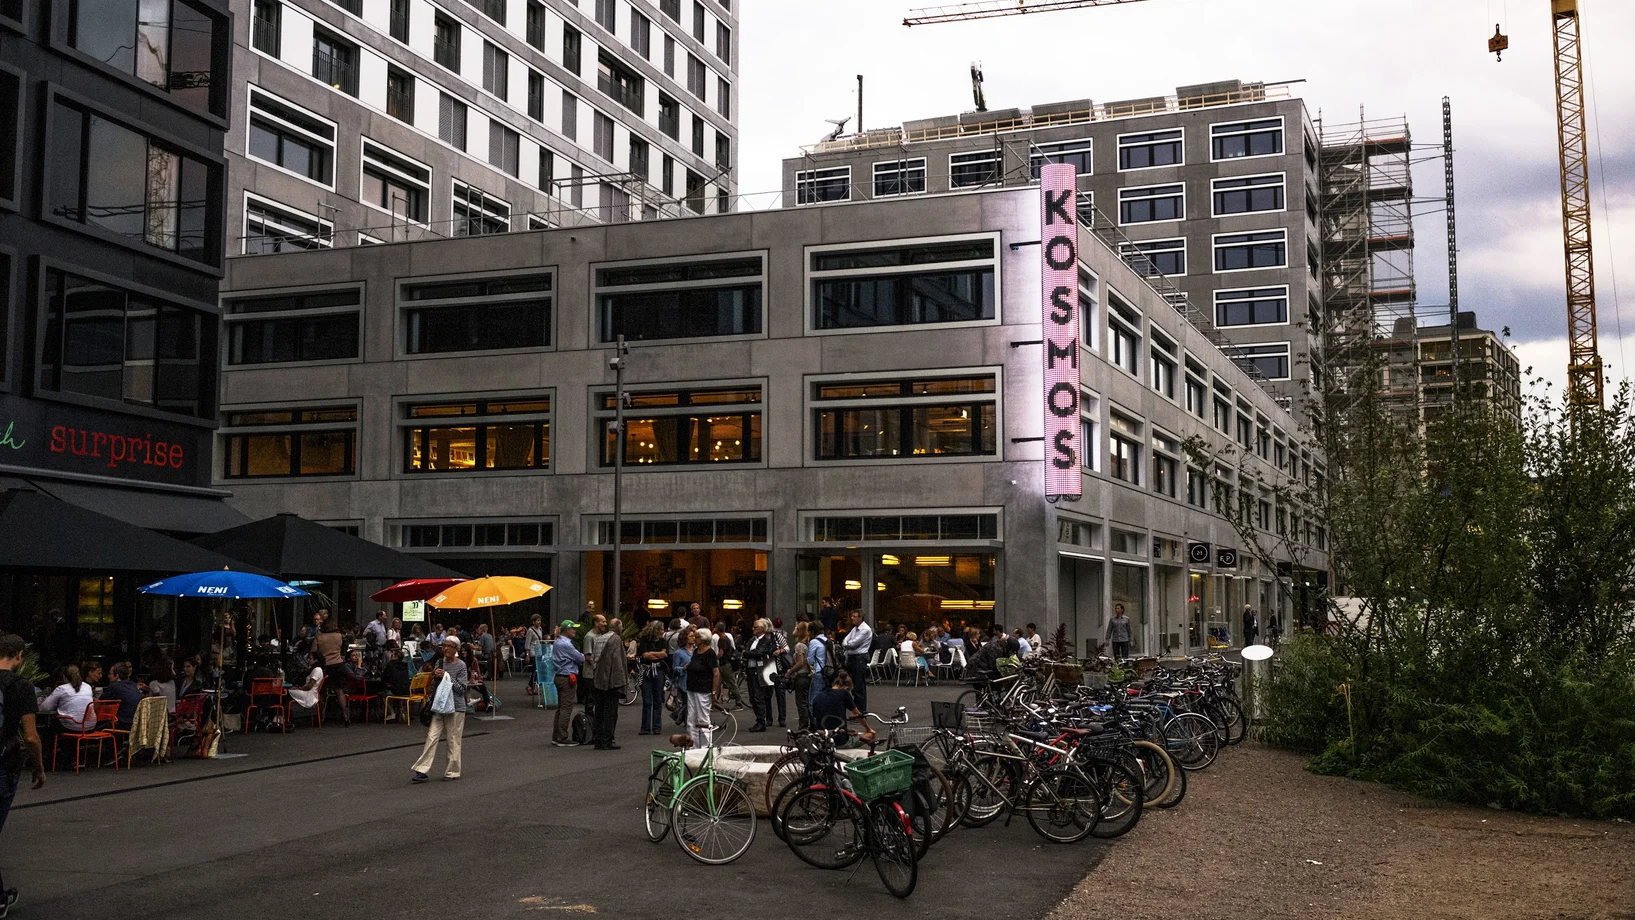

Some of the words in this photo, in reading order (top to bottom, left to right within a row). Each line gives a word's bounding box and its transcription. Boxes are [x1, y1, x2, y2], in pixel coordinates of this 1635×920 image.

[1044, 189, 1078, 469] KOSMOS
[50, 425, 184, 469] surprise
[197, 586, 228, 594] NENI
[478, 595, 499, 604] NENI
